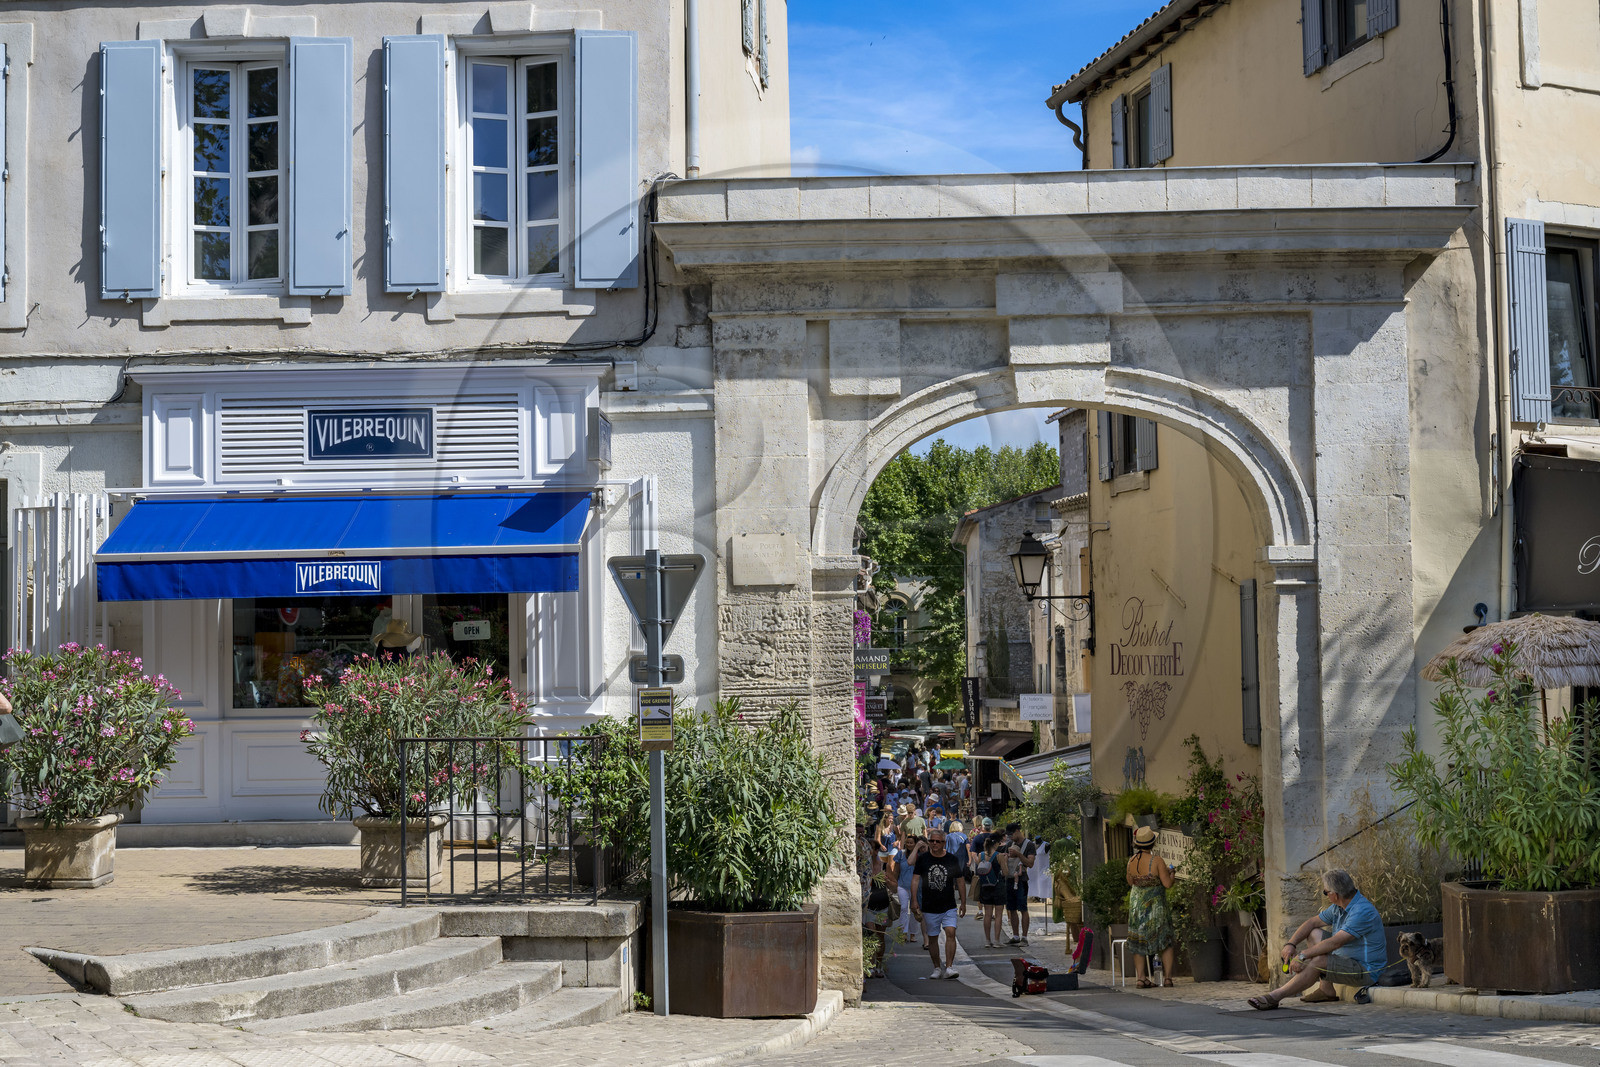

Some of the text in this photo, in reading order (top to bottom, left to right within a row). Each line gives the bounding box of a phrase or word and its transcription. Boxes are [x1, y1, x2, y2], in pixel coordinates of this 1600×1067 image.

[316, 416, 425, 452] VILEBREQUIN
[299, 564, 378, 591] VILEBREQUIN
[464, 626, 480, 635] OPEN
[1120, 597, 1174, 647] Bistrot
[1110, 642, 1184, 676] DECOUVERTE
[966, 680, 976, 724] RESTAURANT
